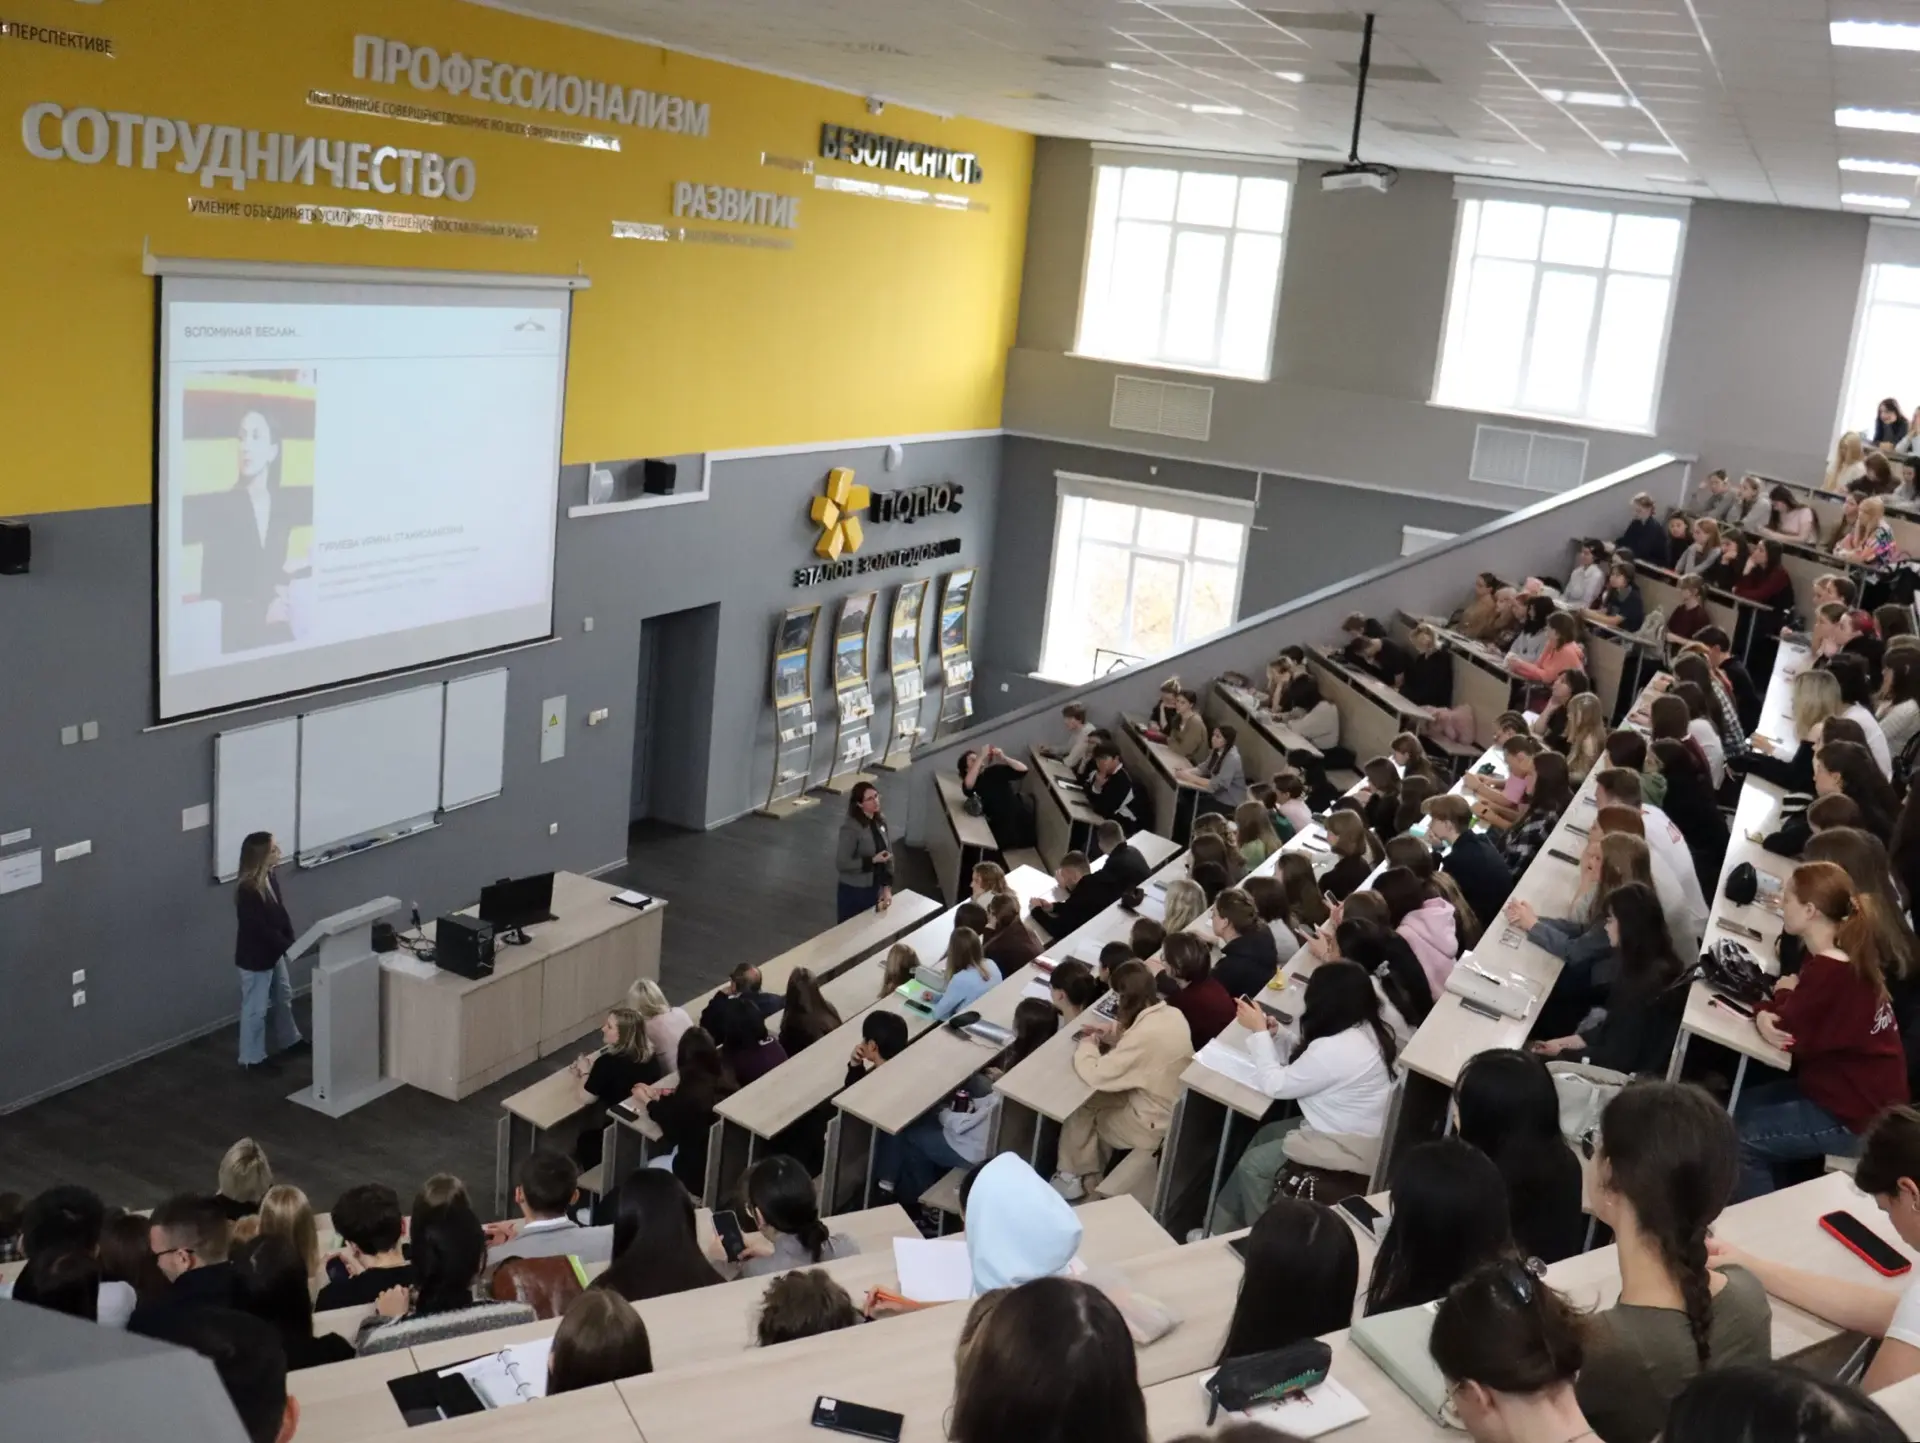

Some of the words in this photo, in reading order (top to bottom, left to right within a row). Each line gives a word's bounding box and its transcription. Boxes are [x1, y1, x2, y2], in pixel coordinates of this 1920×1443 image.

[9, 22, 113, 53] ПЕРСПЕКТИВЕ
[353, 33, 711, 137] ПРОФЕССИОНАЛИЗМ
[21, 102, 477, 202] СОТРУДНИЧЕСТВО
[819, 122, 983, 185] БЕЗОПАСНОСТЬ
[191, 201, 241, 216] УМЕНИЕ
[243, 205, 317, 222] ОБЪЕДИНЯТЬ
[386, 214, 433, 231] РЕШЕНИЯ
[670, 180, 800, 229] РАЗВИТИЕ
[184, 325, 252, 338] ВСПОМИНАЯ
[793, 559, 853, 588] ЭТАЛОН
